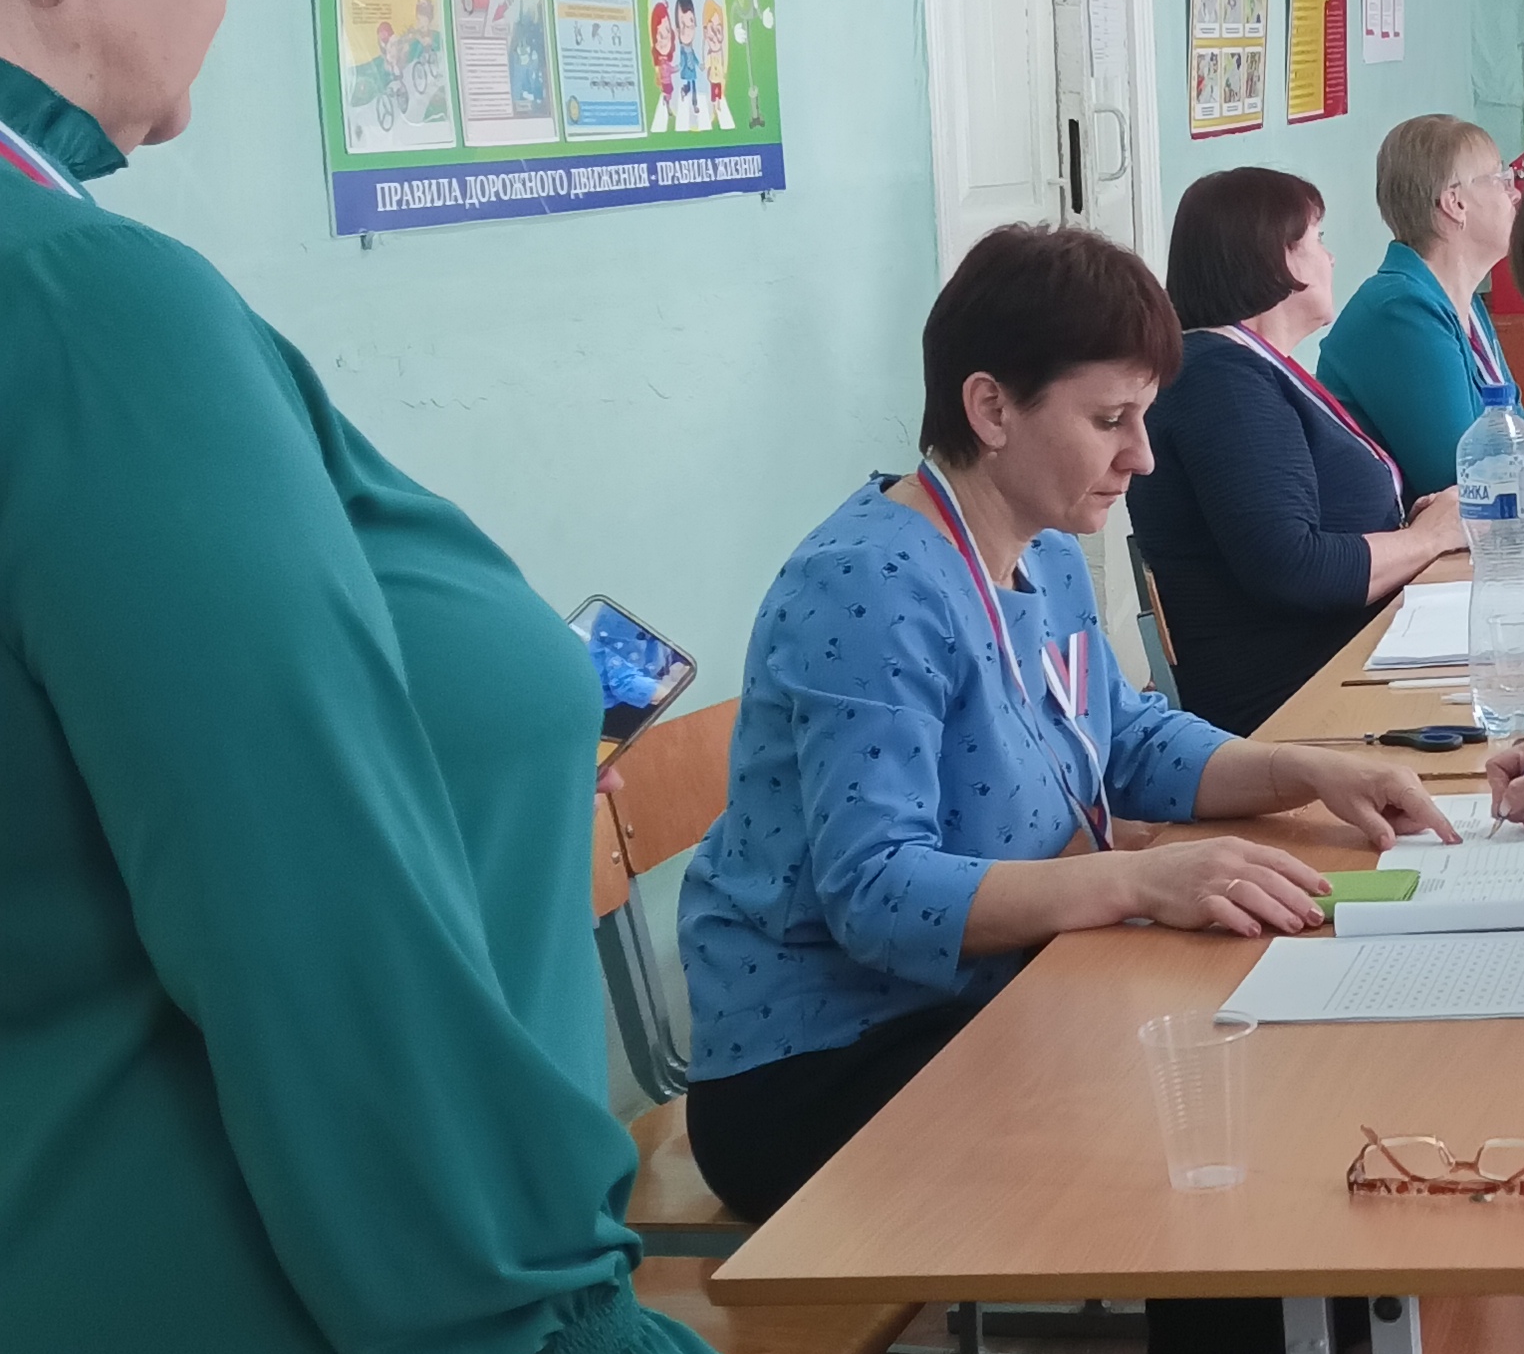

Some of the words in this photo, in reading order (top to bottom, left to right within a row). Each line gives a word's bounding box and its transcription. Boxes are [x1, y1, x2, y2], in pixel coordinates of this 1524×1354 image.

[376, 177, 464, 212] ПРАВИЛА
[465, 170, 568, 209] ДОРОЖНОГО
[570, 163, 650, 199] ДВИЖЕНИЯ
[656, 157, 715, 186] ПРАВИЛА
[715, 155, 763, 181] ЖИЗНИ!
